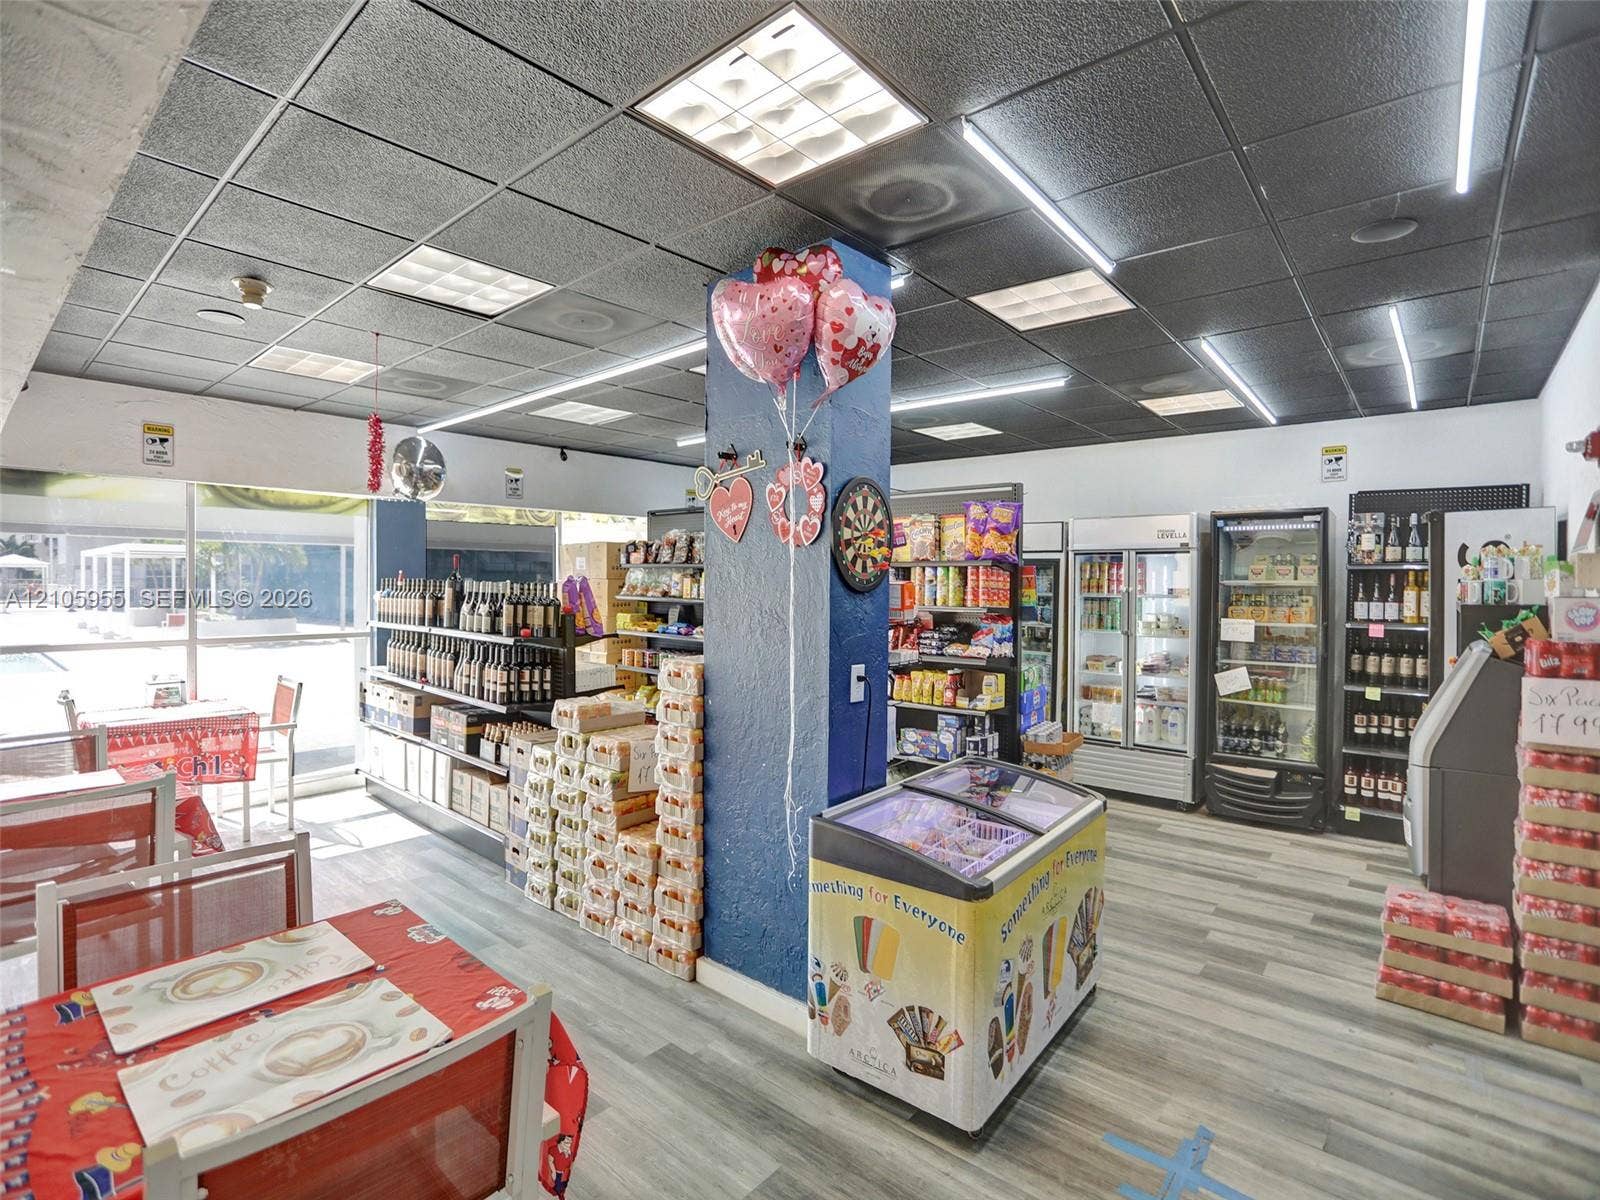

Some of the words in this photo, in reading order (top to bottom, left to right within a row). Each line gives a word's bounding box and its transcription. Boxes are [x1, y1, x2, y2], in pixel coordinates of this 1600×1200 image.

[723, 510, 745, 529] Heart
[1156, 532, 1188, 540] LEVELLA
[1528, 687, 1557, 706] Six
[176, 755, 234, 778] Chile
[1001, 870, 1050, 944] Something
[1052, 858, 1065, 876] for
[1065, 847, 1098, 868] Everyone
[809, 880, 864, 901] mething
[868, 886, 889, 904] for
[893, 894, 967, 946] Everyone
[158, 1031, 264, 1092] Coffee
